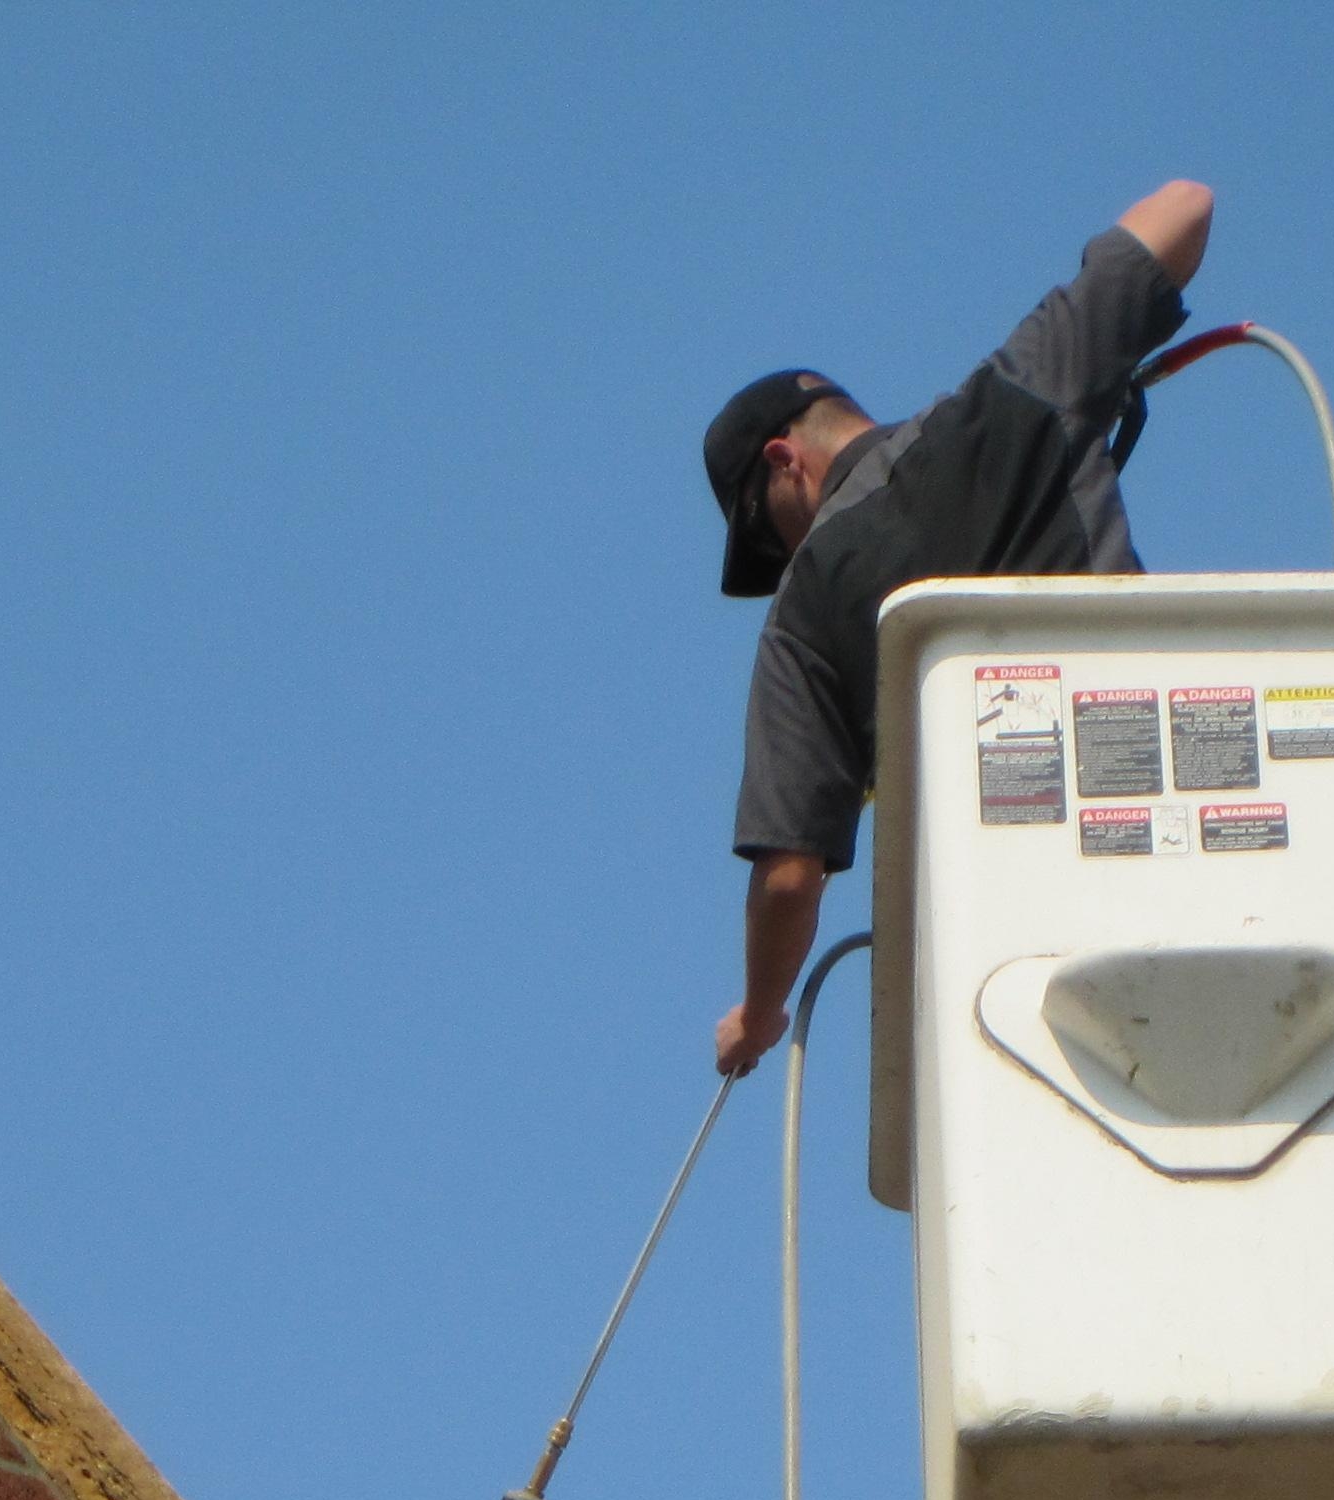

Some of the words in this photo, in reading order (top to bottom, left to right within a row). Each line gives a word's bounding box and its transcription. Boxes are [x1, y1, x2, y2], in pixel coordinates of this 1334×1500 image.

[1000, 668, 1054, 679] DANGER
[1097, 690, 1153, 702] DANGER
[1188, 688, 1252, 701] DANGER
[1095, 810, 1149, 821] DANGER
[1219, 806, 1283, 817] WARNING
